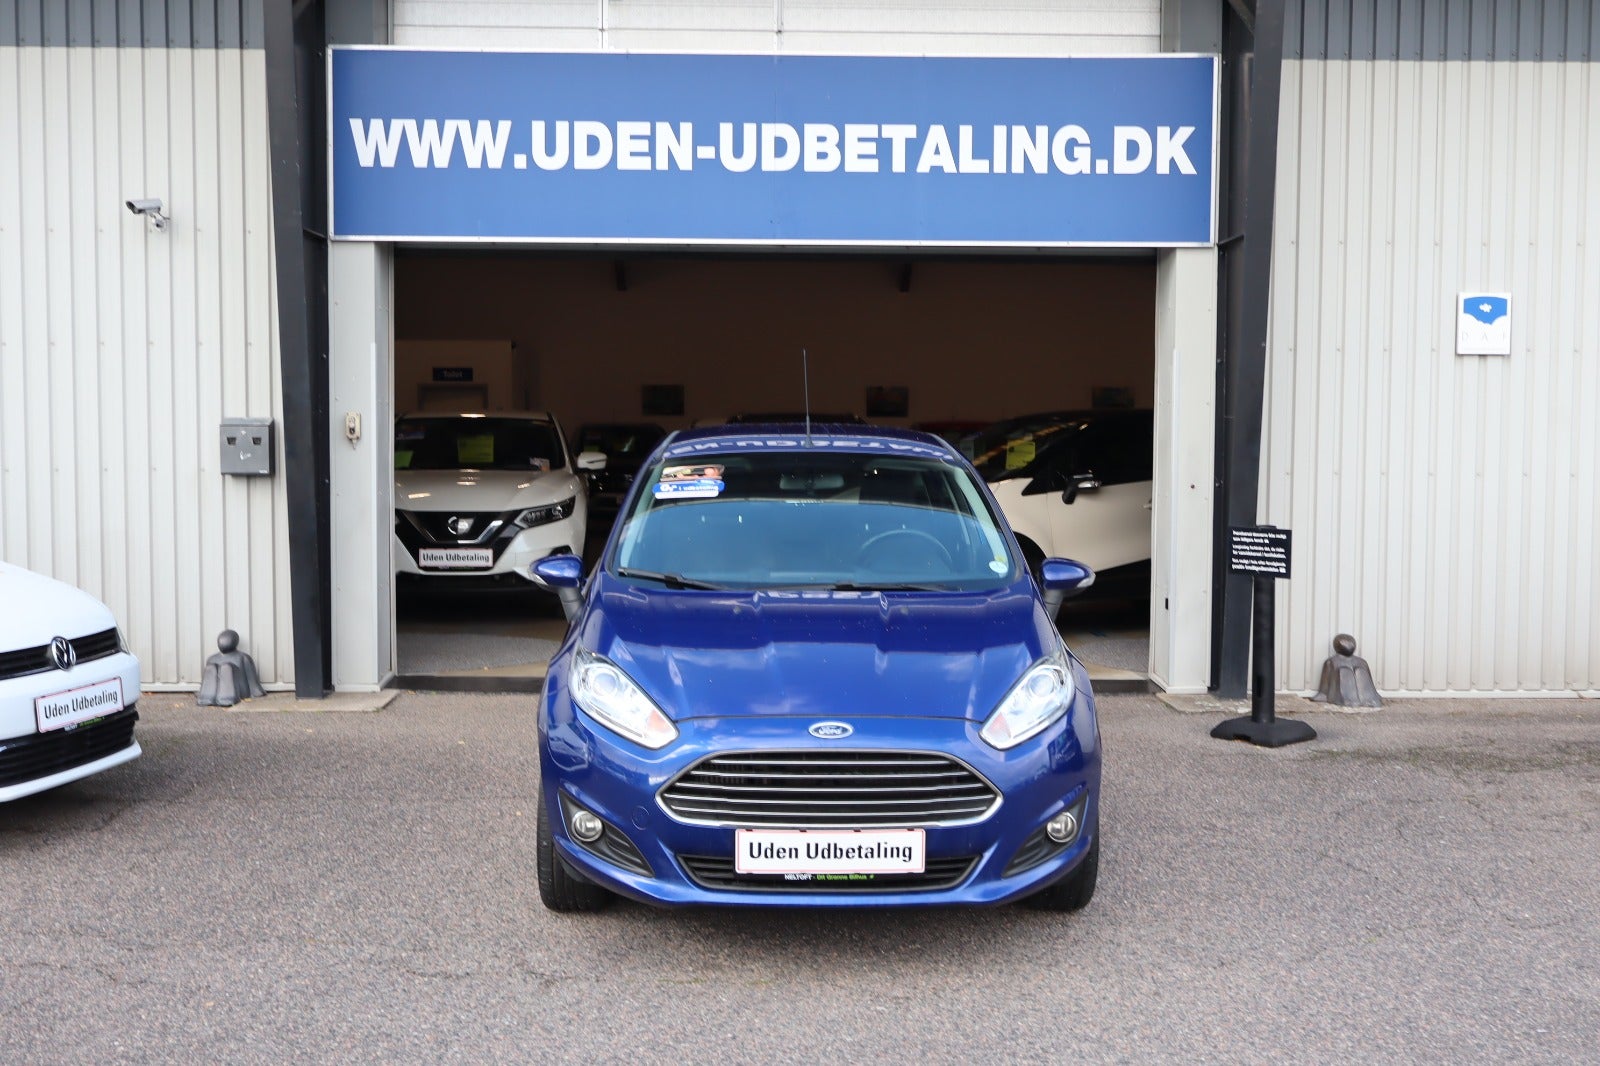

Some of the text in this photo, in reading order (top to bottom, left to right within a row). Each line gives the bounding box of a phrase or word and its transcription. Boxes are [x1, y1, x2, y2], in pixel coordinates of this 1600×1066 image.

[348, 117, 1198, 176] WWW.UDEN-UDBETALING.DK
[422, 552, 490, 563] Uden Udbetaling
[44, 689, 118, 720] Uden Udbetaling
[749, 841, 913, 863] Uden Udbetaling
